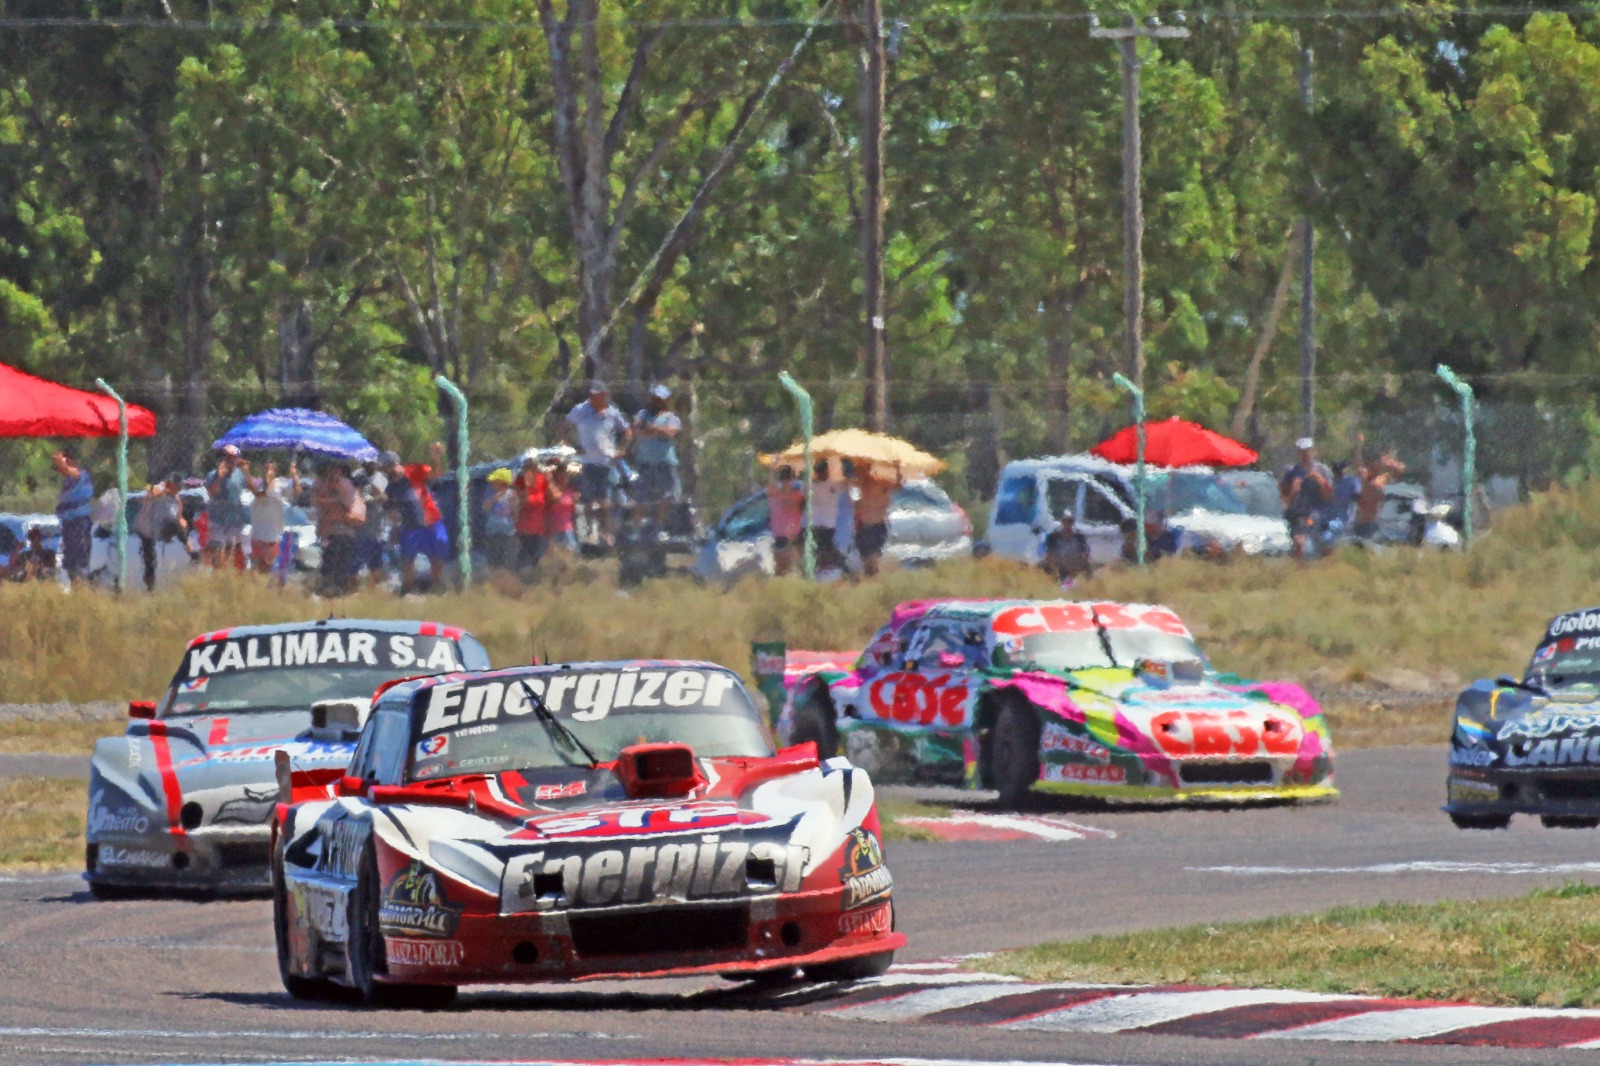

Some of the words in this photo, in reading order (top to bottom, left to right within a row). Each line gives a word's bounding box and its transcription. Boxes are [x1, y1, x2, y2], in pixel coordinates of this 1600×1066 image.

[188, 631, 378, 678] KALIMAR
[389, 635, 467, 673] S.A.
[422, 667, 734, 733] Energizer
[540, 806, 738, 835] STP
